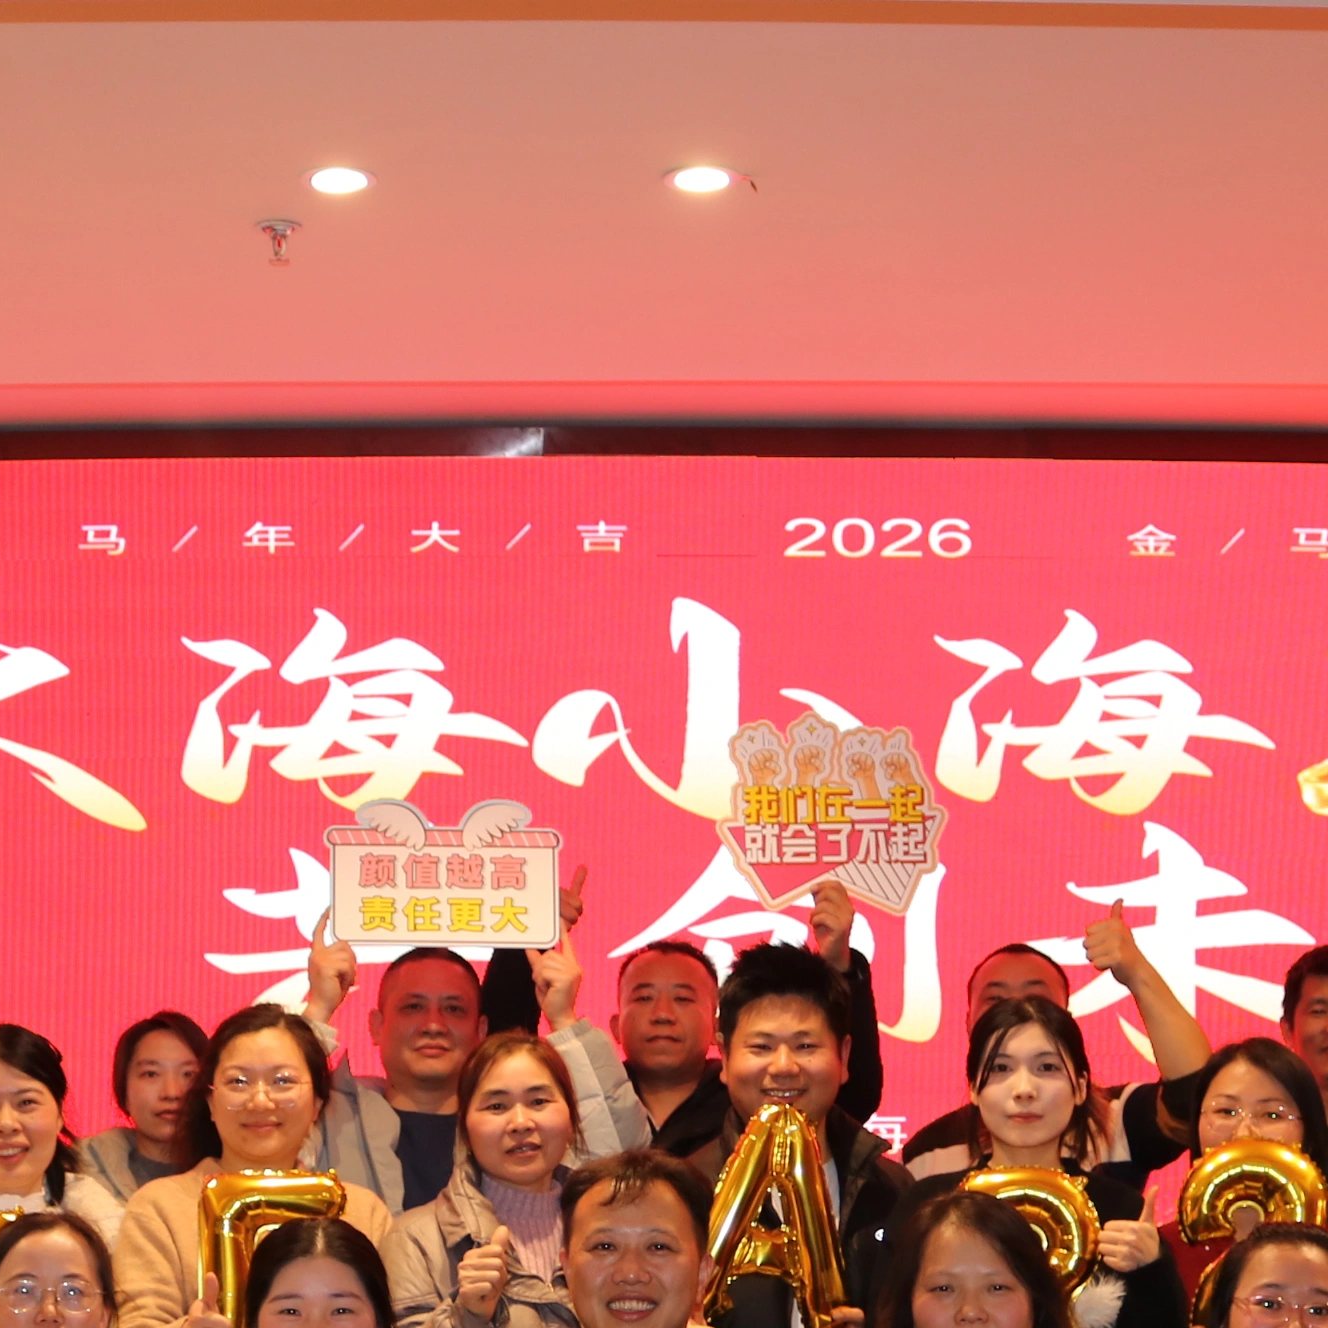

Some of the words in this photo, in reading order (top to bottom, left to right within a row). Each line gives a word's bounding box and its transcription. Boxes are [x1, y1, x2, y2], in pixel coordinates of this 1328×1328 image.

[782, 516, 974, 559] 2026
[743, 784, 924, 823] 我们在一起
[744, 823, 927, 864] 就会了不起
[359, 853, 527, 890] 颜值越高
[359, 896, 528, 933] 责任更大
